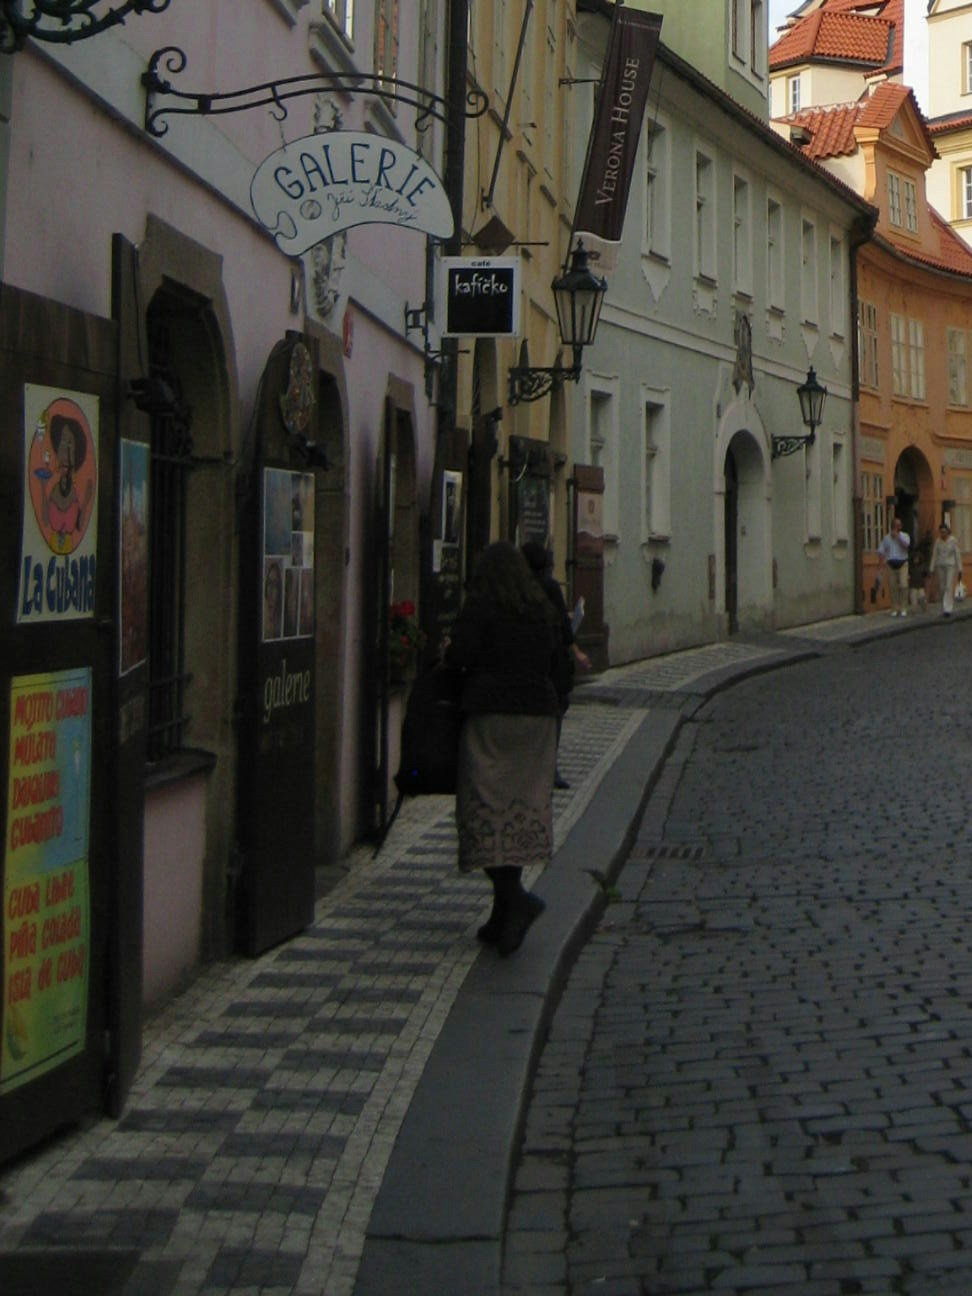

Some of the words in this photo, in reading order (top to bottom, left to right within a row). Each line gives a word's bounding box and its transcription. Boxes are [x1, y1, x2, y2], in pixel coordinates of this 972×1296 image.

[609, 57, 641, 123] HOUSE
[274, 143, 436, 207] GALERIE
[594, 130, 627, 207] VERONA
[22, 555, 44, 615] La
[46, 554, 96, 614] Cubana
[263, 657, 311, 724] galerie
